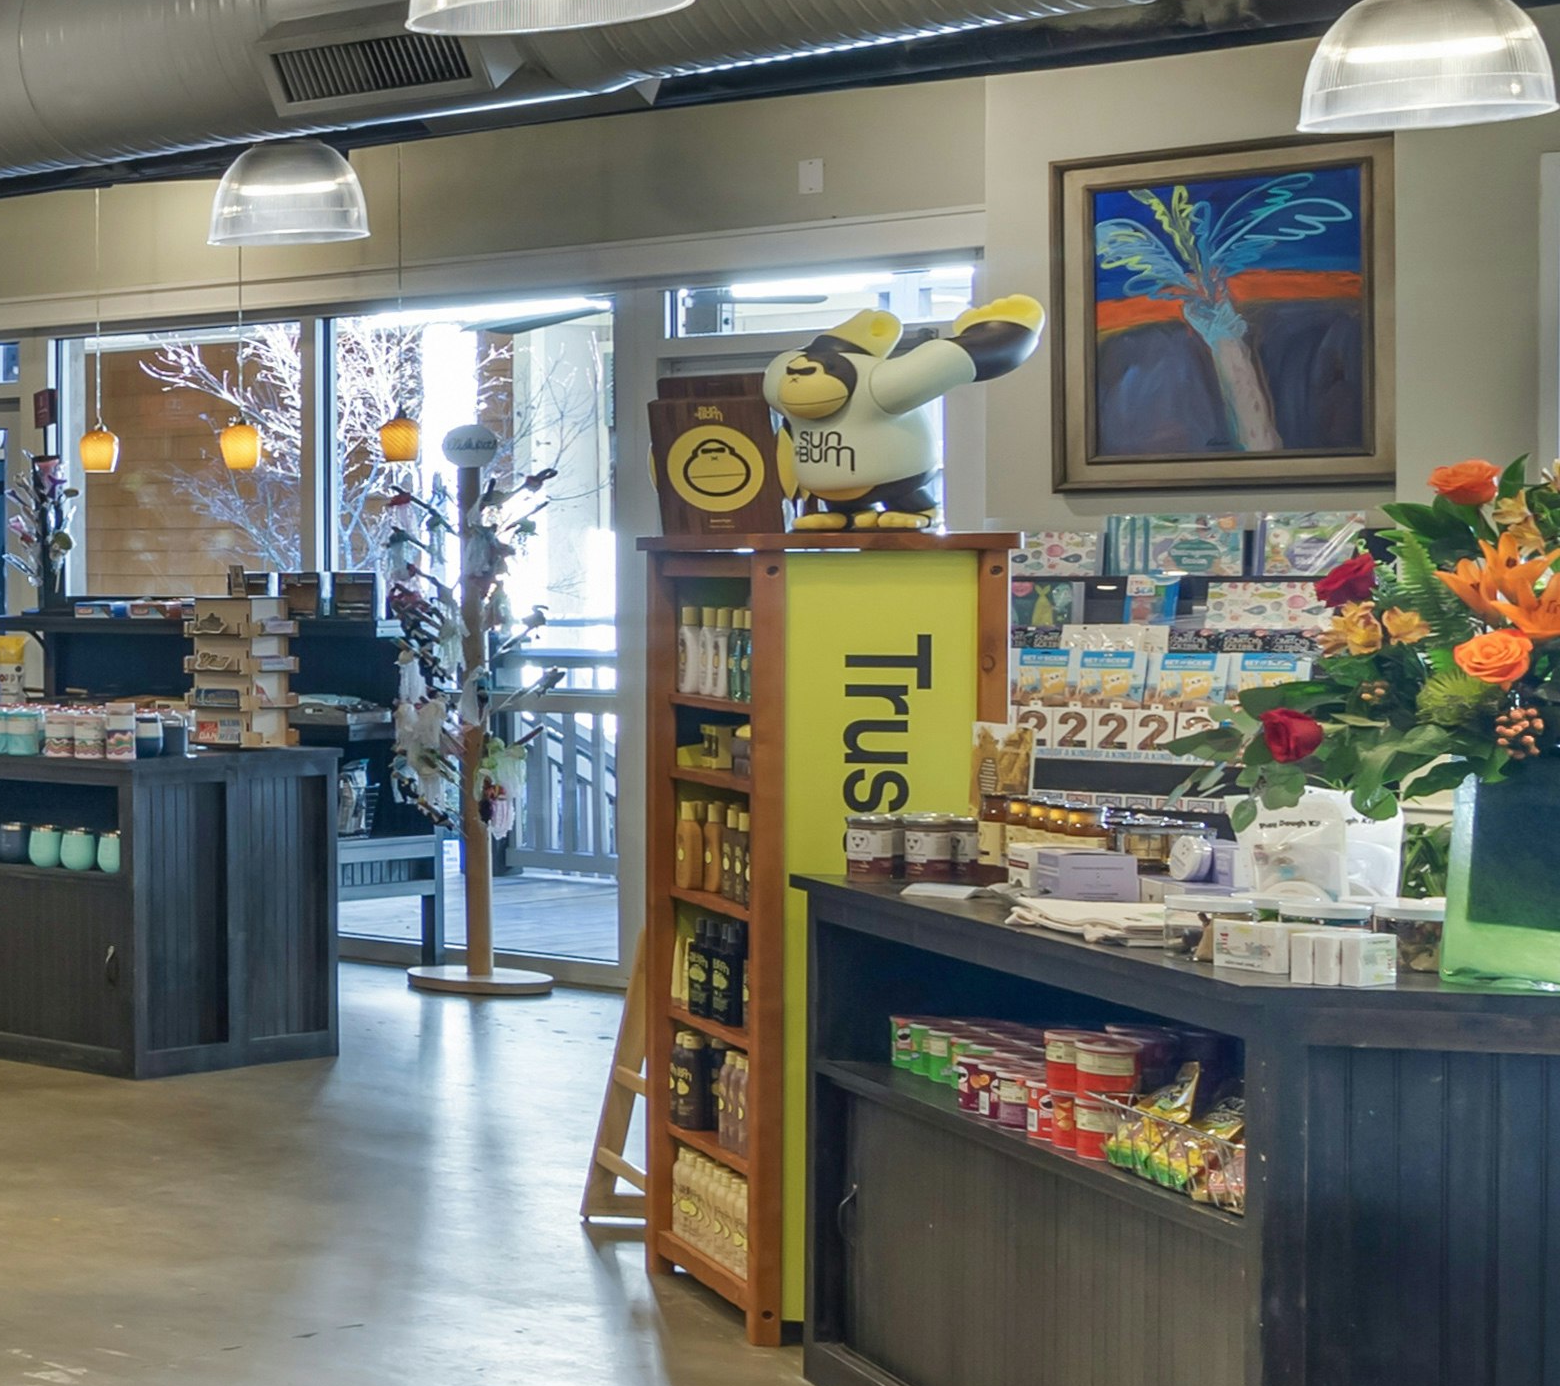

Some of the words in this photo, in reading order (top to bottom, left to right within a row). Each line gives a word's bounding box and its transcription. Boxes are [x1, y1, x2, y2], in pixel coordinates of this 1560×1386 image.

[843, 634, 931, 852] Trus
[1058, 711, 1087, 748] 2
[1098, 713, 1128, 750] 2
[1137, 714, 1169, 751] 2
